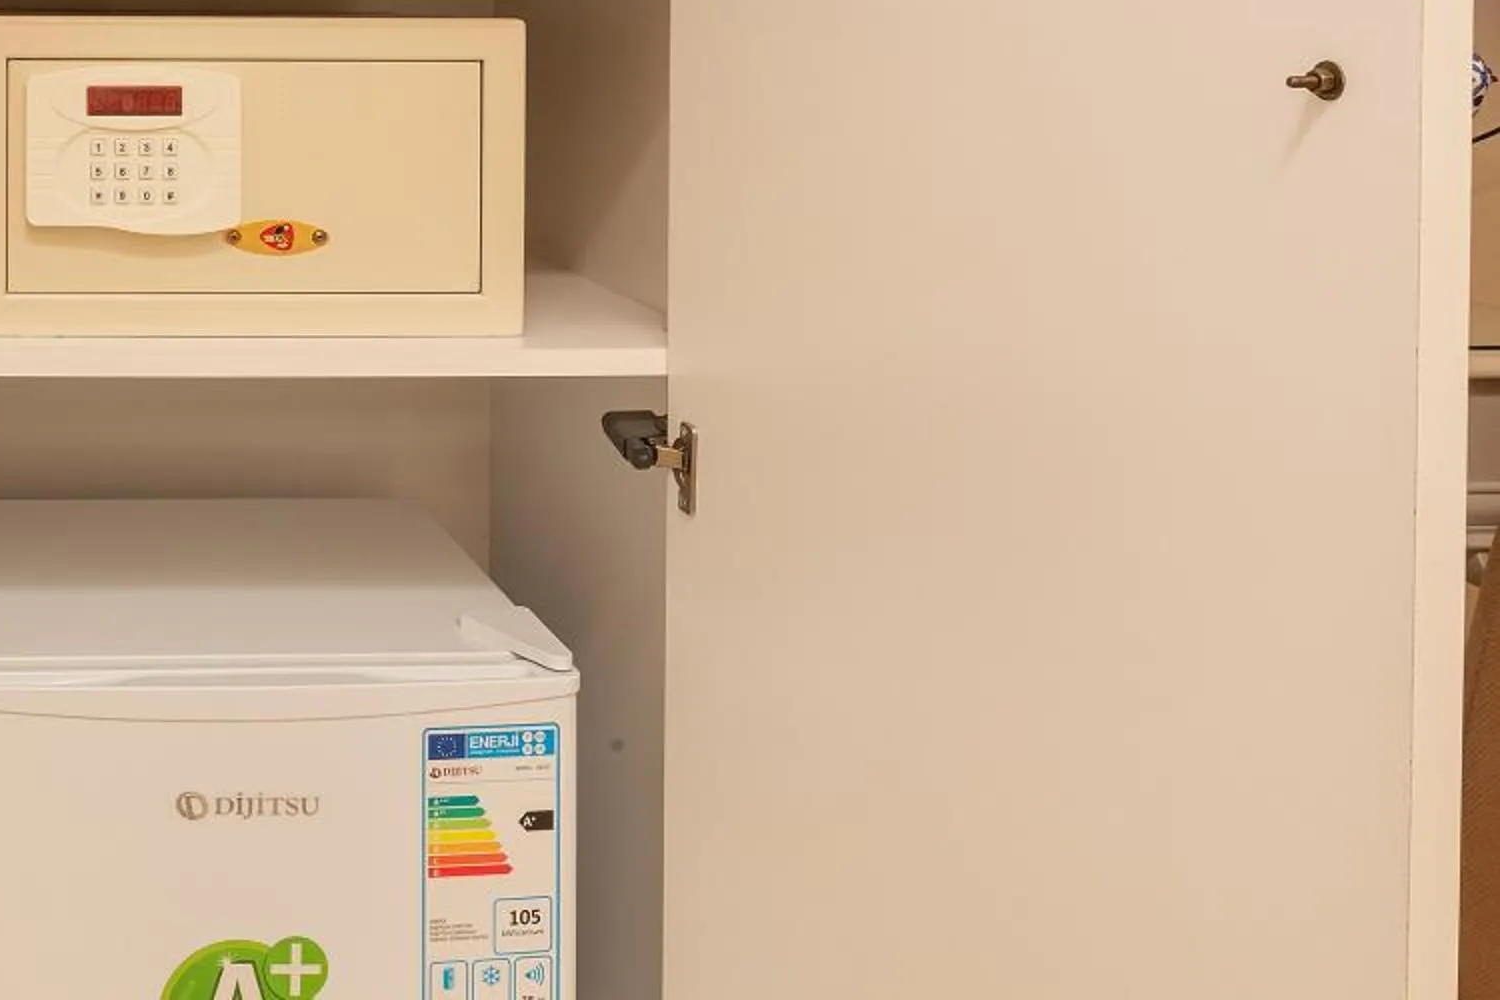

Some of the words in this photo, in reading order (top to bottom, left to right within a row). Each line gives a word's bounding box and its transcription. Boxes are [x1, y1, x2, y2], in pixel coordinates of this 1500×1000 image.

[119, 143, 126, 153] 2
[143, 143, 151, 153] 3
[167, 143, 174, 153] 4
[143, 190, 151, 201] 0
[509, 909, 541, 926] 105
